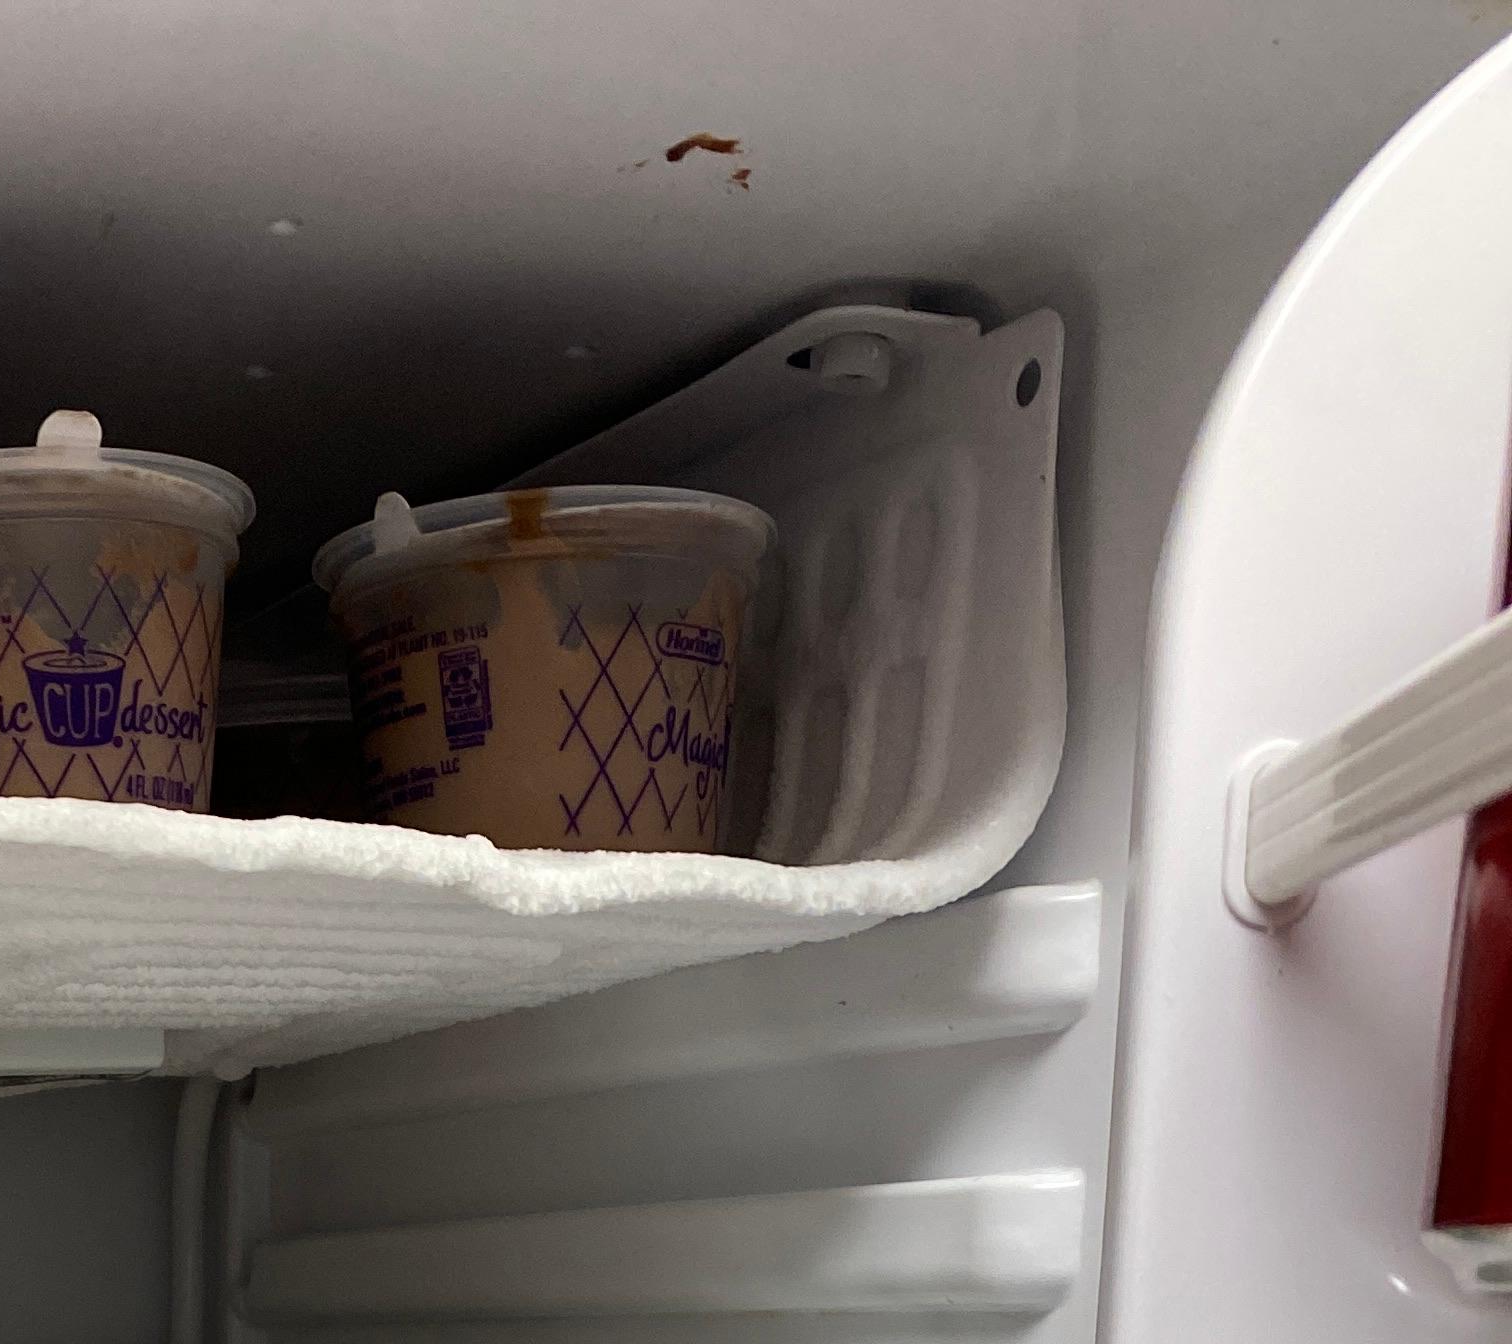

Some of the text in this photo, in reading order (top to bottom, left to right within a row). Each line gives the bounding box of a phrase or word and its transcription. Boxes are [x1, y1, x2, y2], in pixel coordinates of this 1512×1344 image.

[666, 626, 721, 659] Hormel
[43, 680, 113, 741] CUP
[121, 679, 208, 744] dessert
[648, 706, 726, 800] Magic
